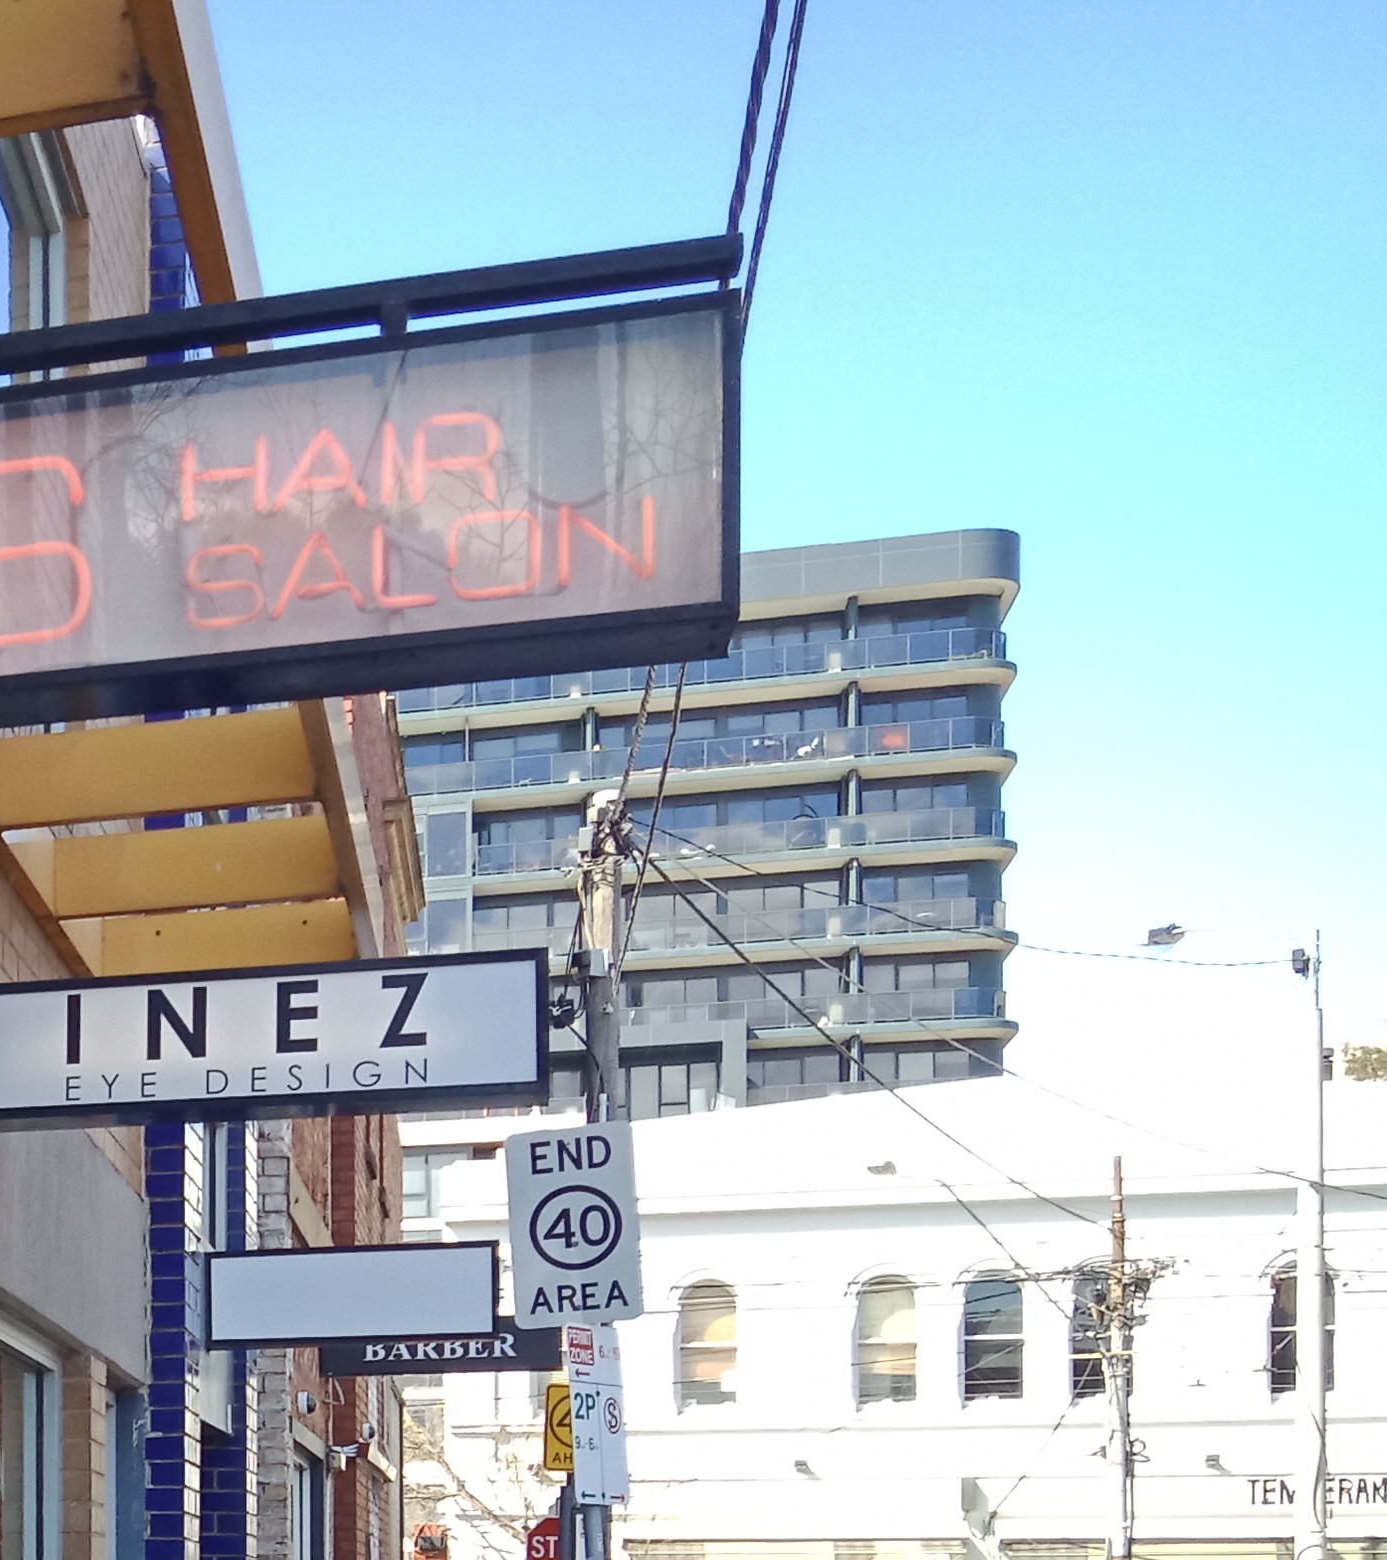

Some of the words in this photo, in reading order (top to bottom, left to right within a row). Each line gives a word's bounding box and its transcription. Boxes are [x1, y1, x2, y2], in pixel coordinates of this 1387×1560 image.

[179, 412, 504, 523] HAIR
[185, 495, 656, 630] SALON
[66, 973, 429, 1065] INEZ
[65, 1072, 157, 1101] EYE
[206, 1058, 428, 1094] DESIGN
[530, 1135, 611, 1175] END
[543, 1205, 610, 1249] 40
[530, 1280, 629, 1315] AREA
[363, 1333, 518, 1362] BARBER
[570, 1347, 593, 1364] ZONE
[574, 1392, 596, 1420] 2P
[531, 1535, 559, 1559] ST
